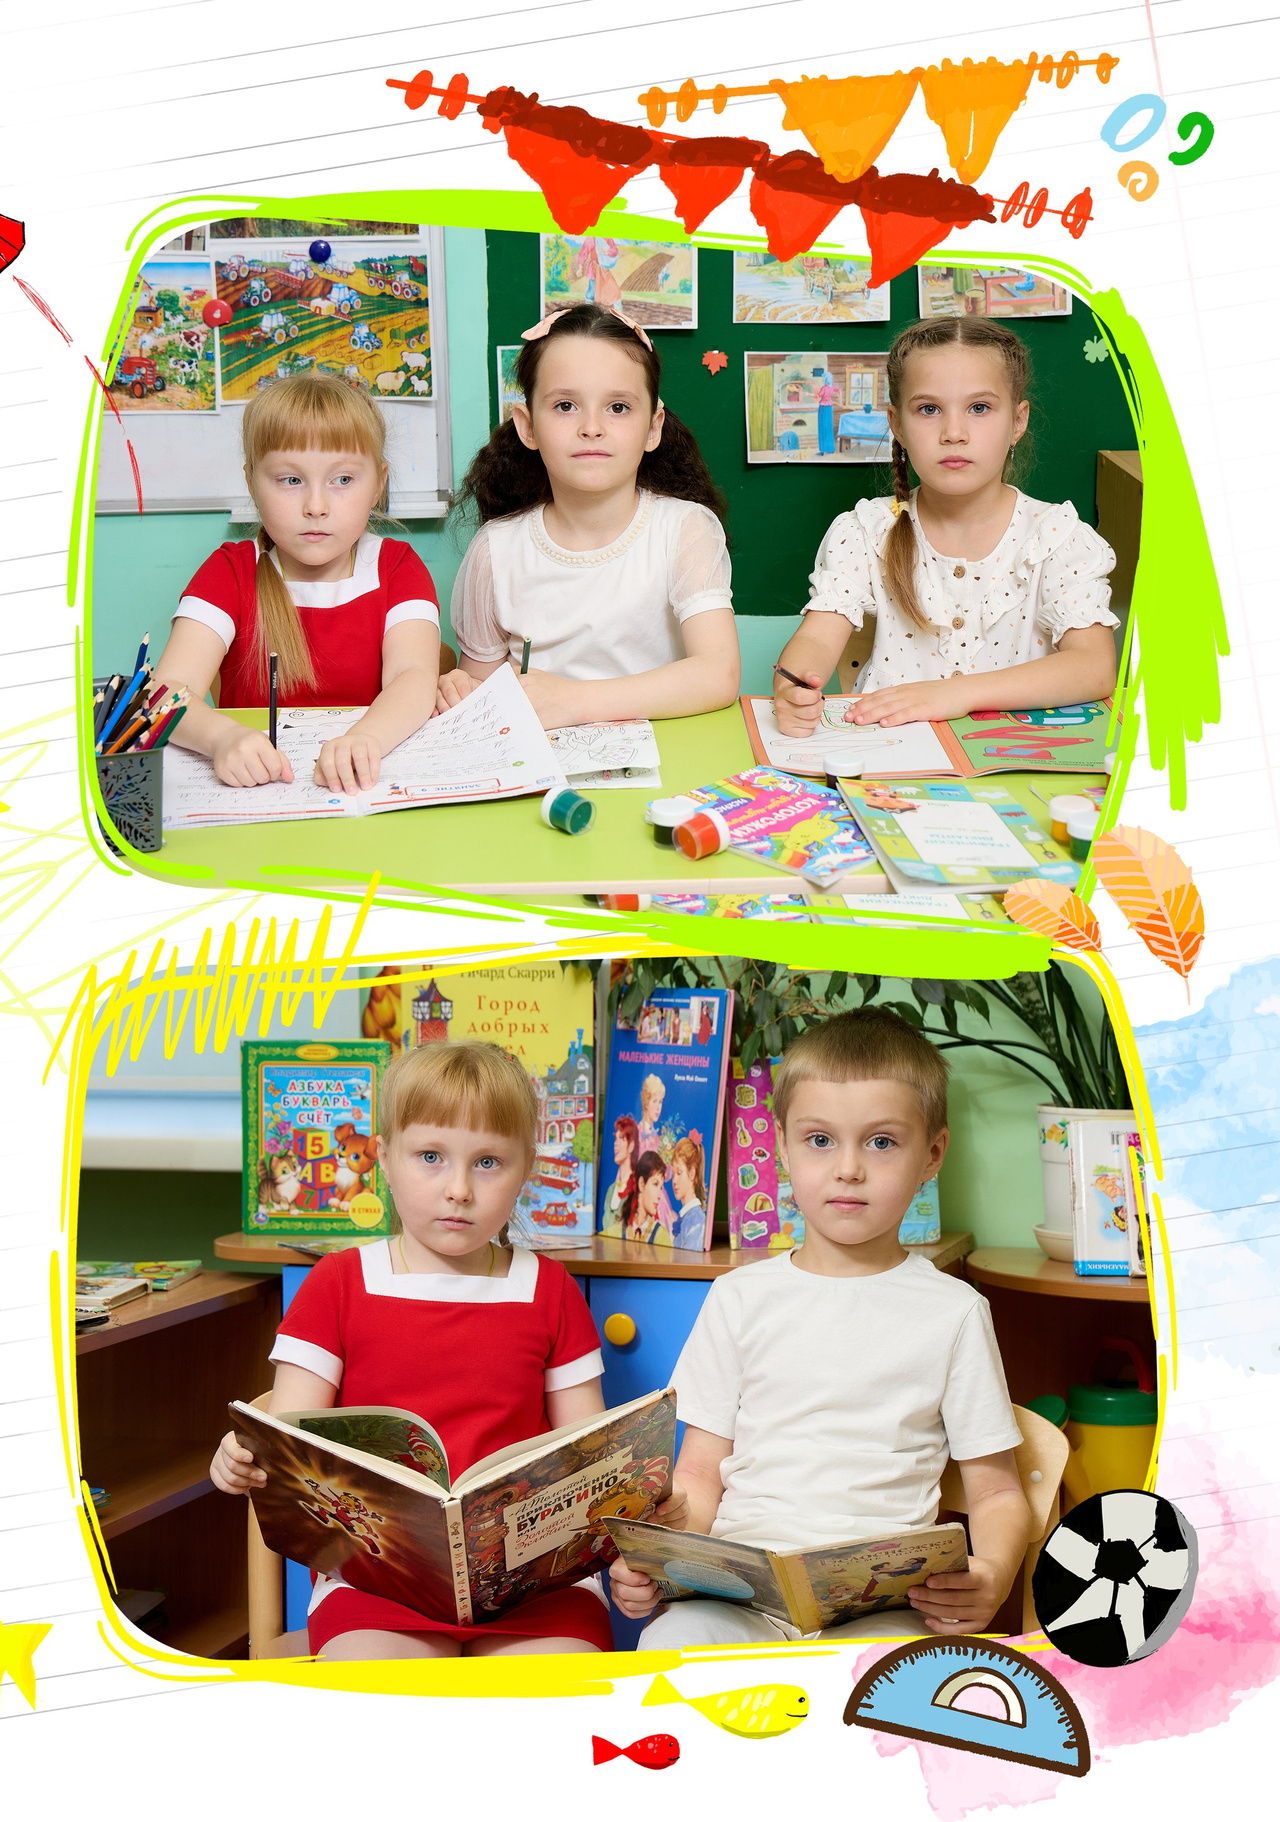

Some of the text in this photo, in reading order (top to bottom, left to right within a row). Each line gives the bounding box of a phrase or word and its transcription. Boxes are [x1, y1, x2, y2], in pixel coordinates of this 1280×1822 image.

[508, 967, 555, 983] Скарри
[478, 995, 540, 1015] Город
[468, 1018, 549, 1037] добрых
[504, 1045, 526, 1056] ел
[619, 1051, 710, 1068] МАЛЕНЬКИЕ ЖЕНЩИНЫ
[288, 1081, 344, 1092] АЗБУКА
[282, 1096, 350, 1107] БУКВАРЬ
[298, 1110, 331, 1123] СЧЁТ
[310, 1137, 323, 1155] 5
[517, 1468, 618, 1522] ПРИКЛЮЧЕНИЯ
